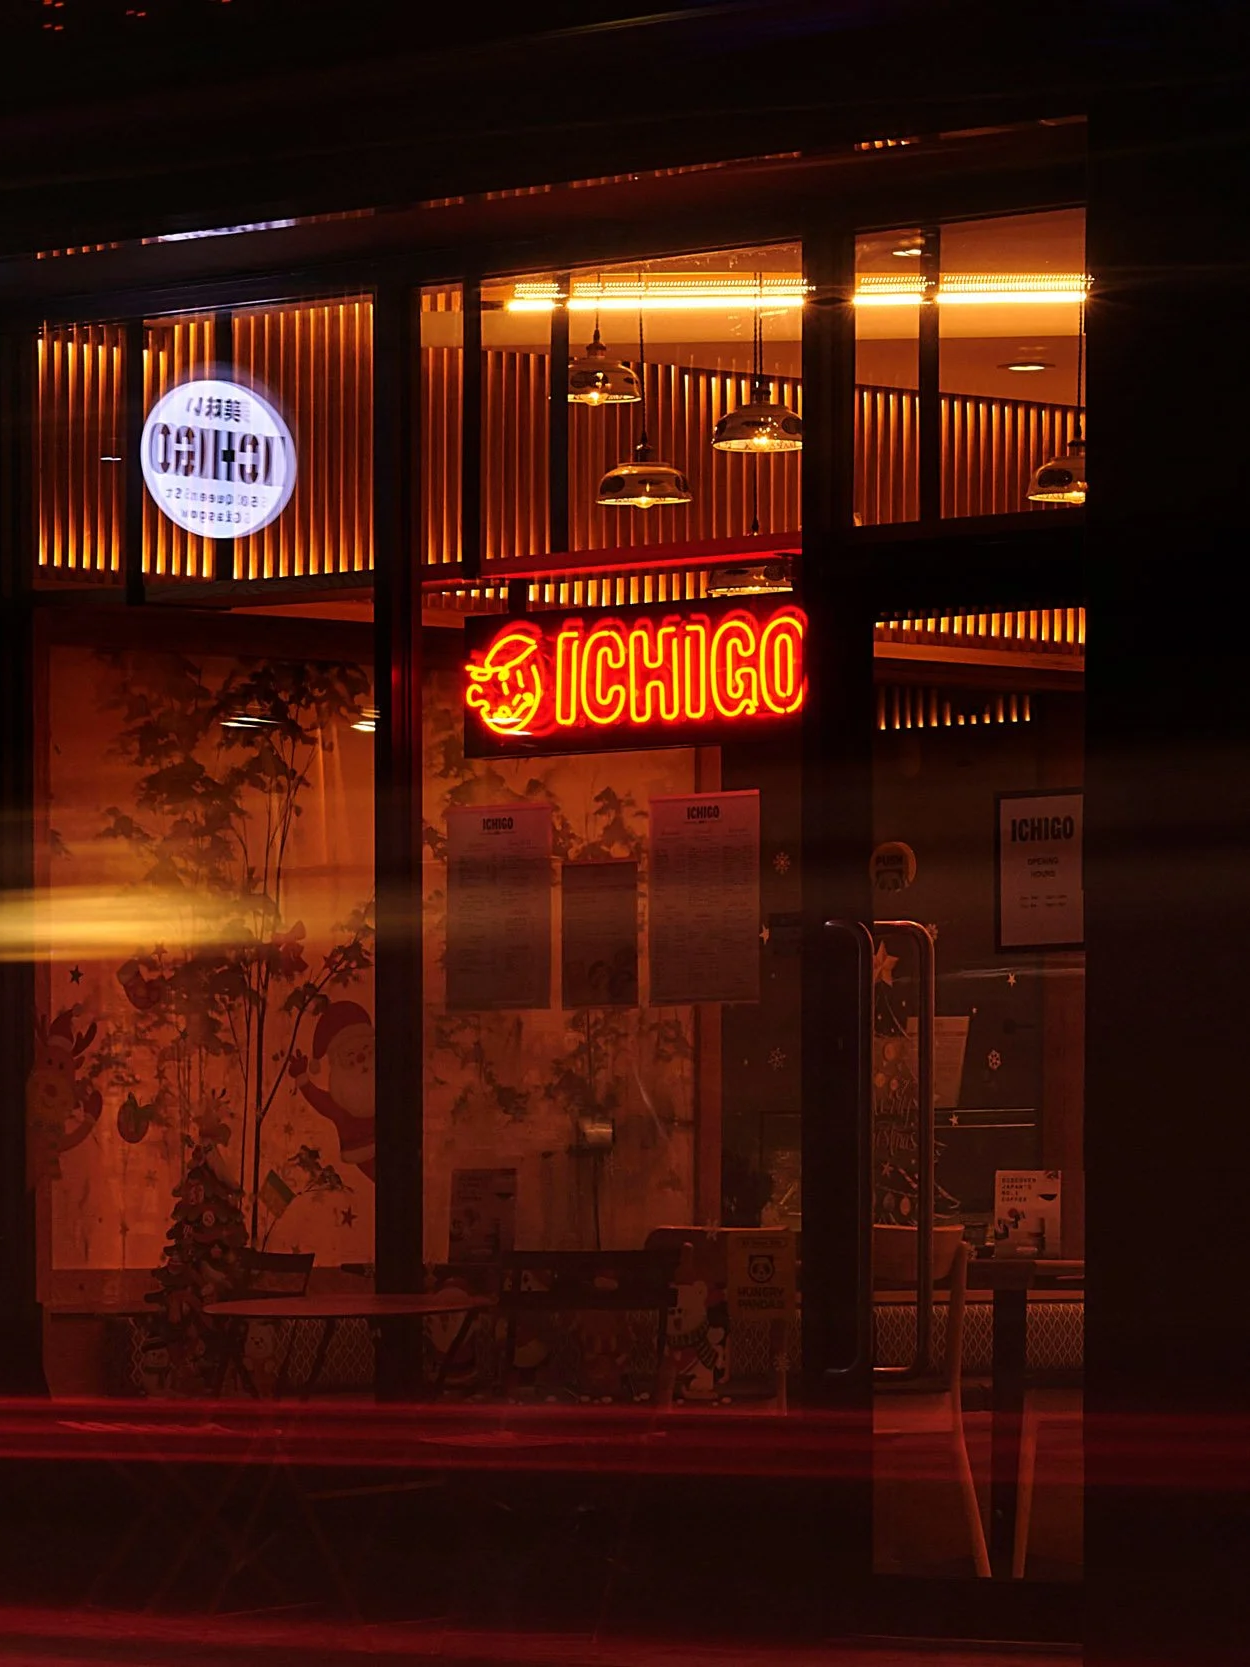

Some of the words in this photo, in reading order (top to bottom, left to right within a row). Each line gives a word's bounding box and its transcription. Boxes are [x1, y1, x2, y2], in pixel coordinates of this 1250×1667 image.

[554, 612, 805, 725] ICHIGO
[686, 805, 720, 820] ICHIGO
[482, 817, 514, 831] ICHIGO
[1011, 816, 1074, 842] ICHIGO
[875, 854, 903, 866] PUSH
[1027, 856, 1059, 866] OPENING
[737, 1287, 785, 1297] HUNGRY
